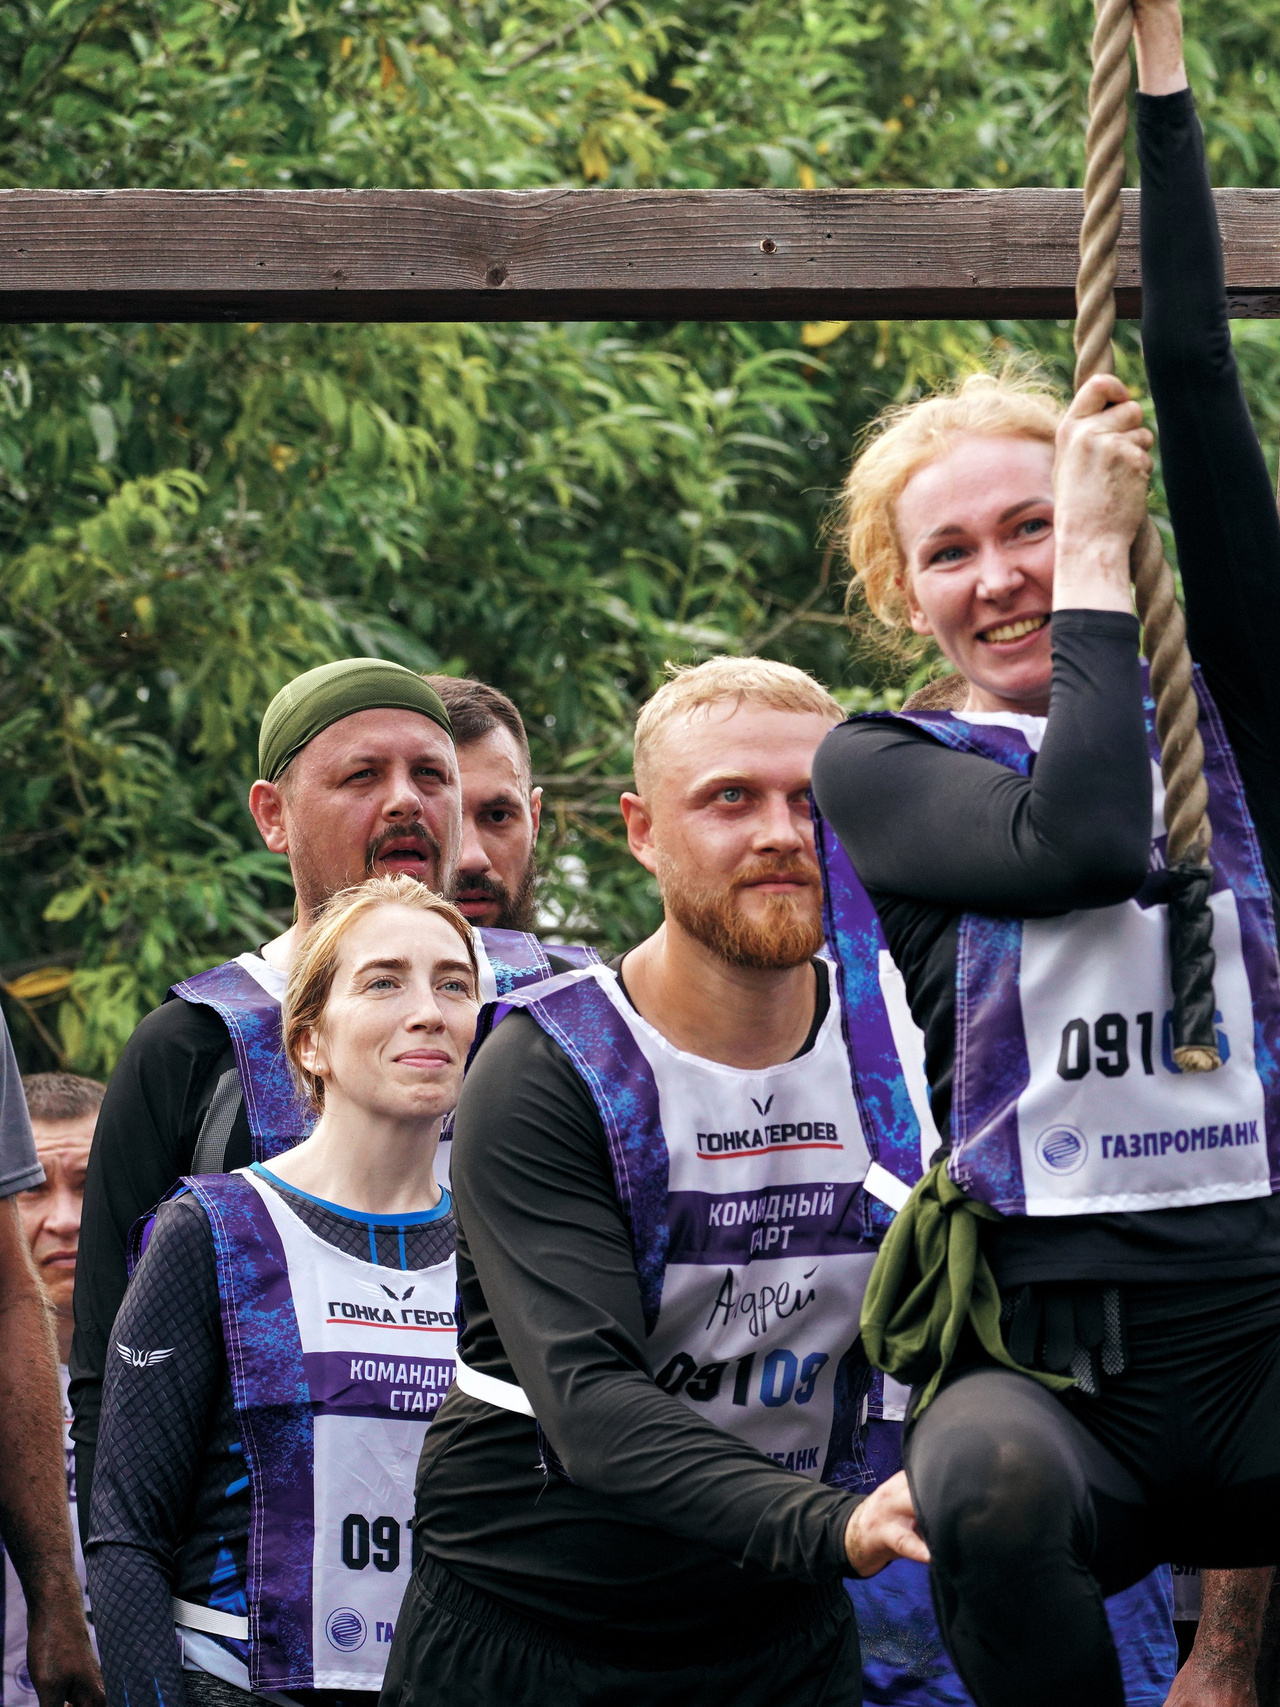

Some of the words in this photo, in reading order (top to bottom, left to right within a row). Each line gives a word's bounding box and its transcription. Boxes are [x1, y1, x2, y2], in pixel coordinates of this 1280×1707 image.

[696, 1129, 764, 1153] ГОНКА
[764, 1121, 838, 1145] ГЕРОЕВ
[1101, 1119, 1259, 1159] ГАЗПРОМБАНК
[328, 1301, 397, 1324] ГОНКА
[401, 1309, 457, 1326] ГЕРО
[654, 1348, 830, 1408] 09109
